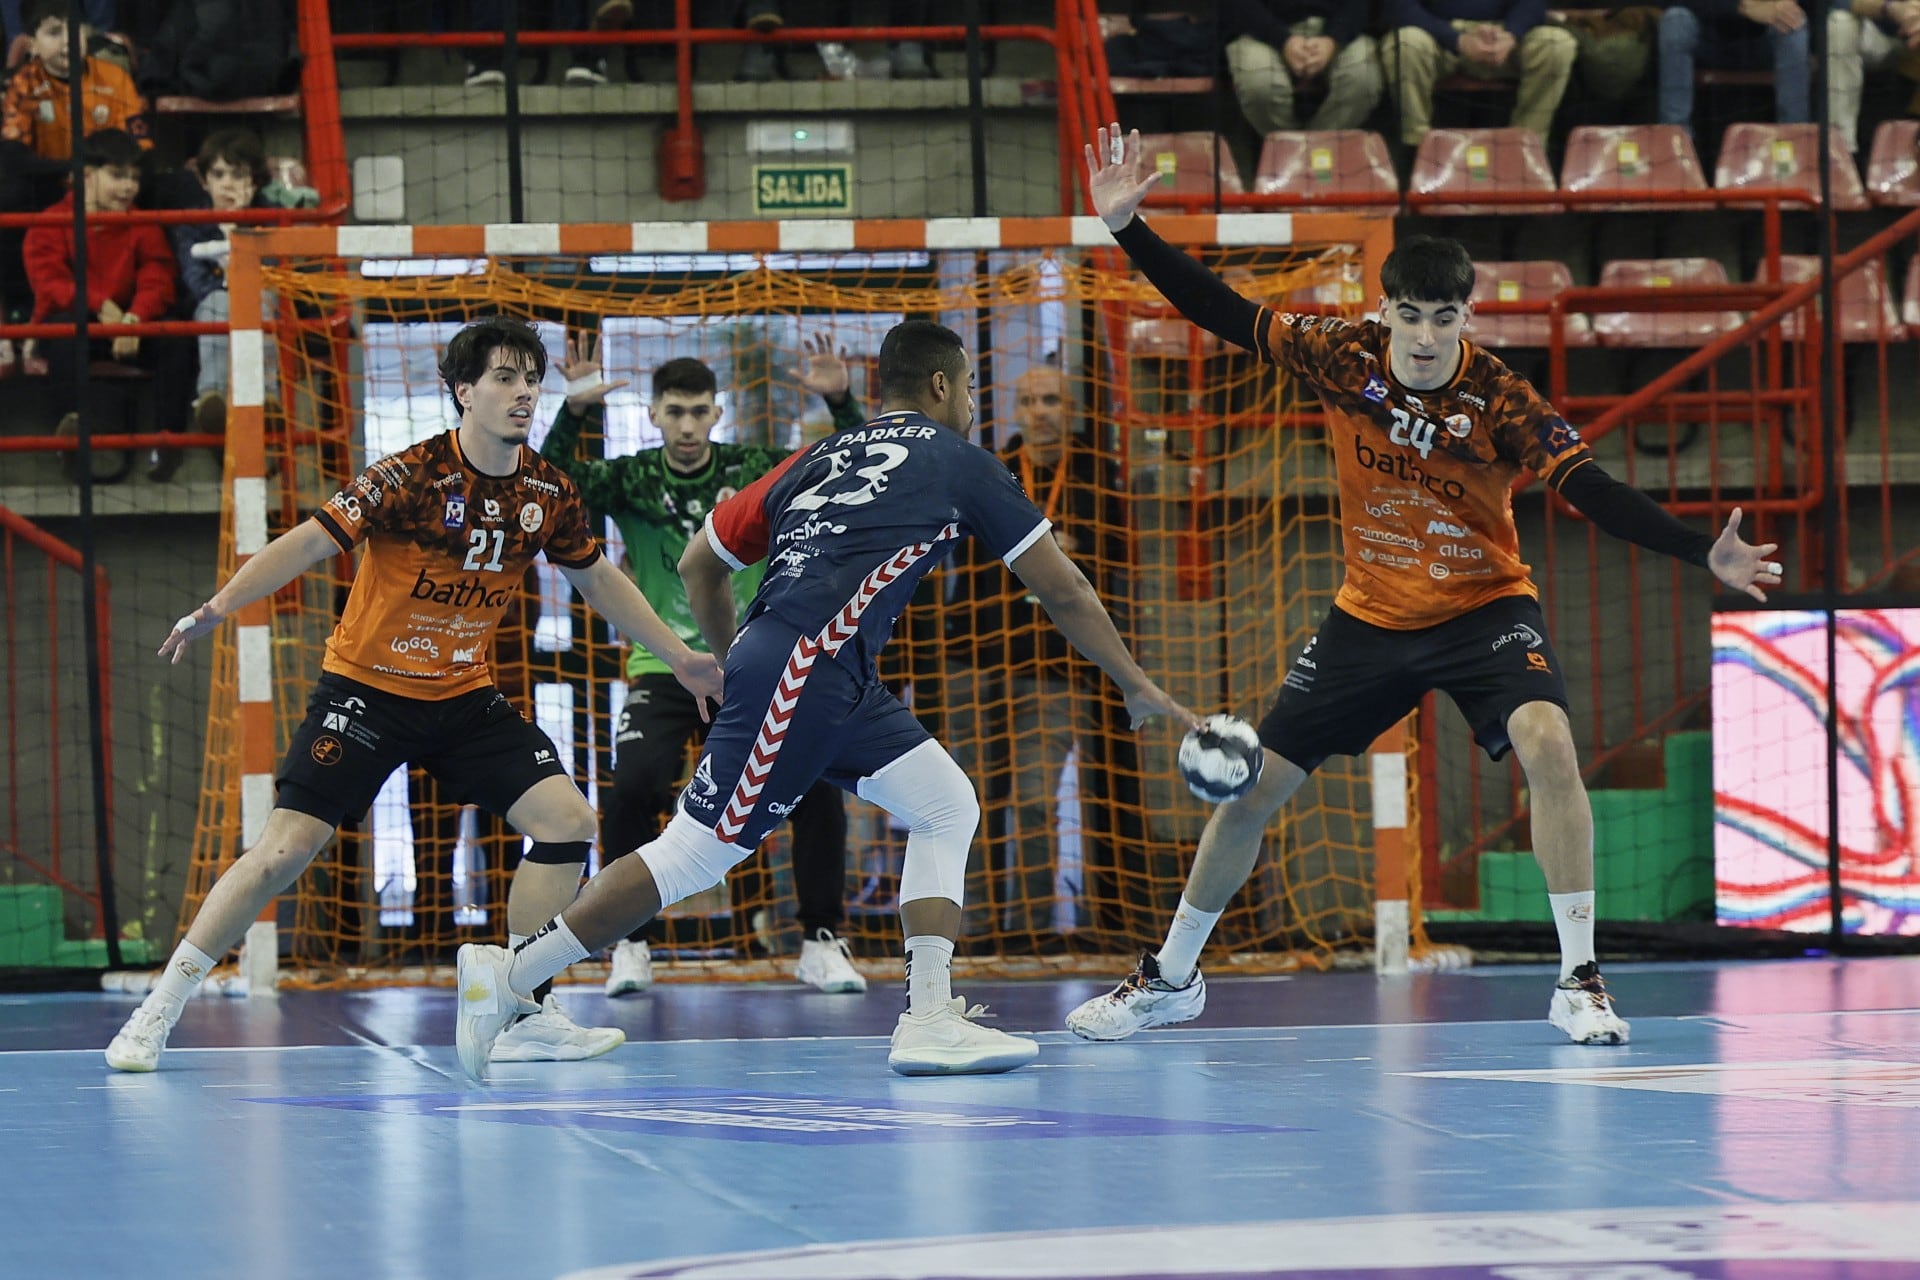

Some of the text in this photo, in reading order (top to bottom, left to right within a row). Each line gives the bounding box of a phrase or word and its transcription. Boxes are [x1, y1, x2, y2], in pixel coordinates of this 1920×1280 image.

[760, 174, 843, 204] SALIDA
[835, 425, 937, 447] PARKER
[1390, 407, 1436, 459] 24
[784, 442, 909, 513] 23
[1355, 434, 1465, 500] bathco
[463, 528, 505, 572] 21
[1439, 543, 1482, 560] alsa
[390, 636, 440, 658] LOGOS
